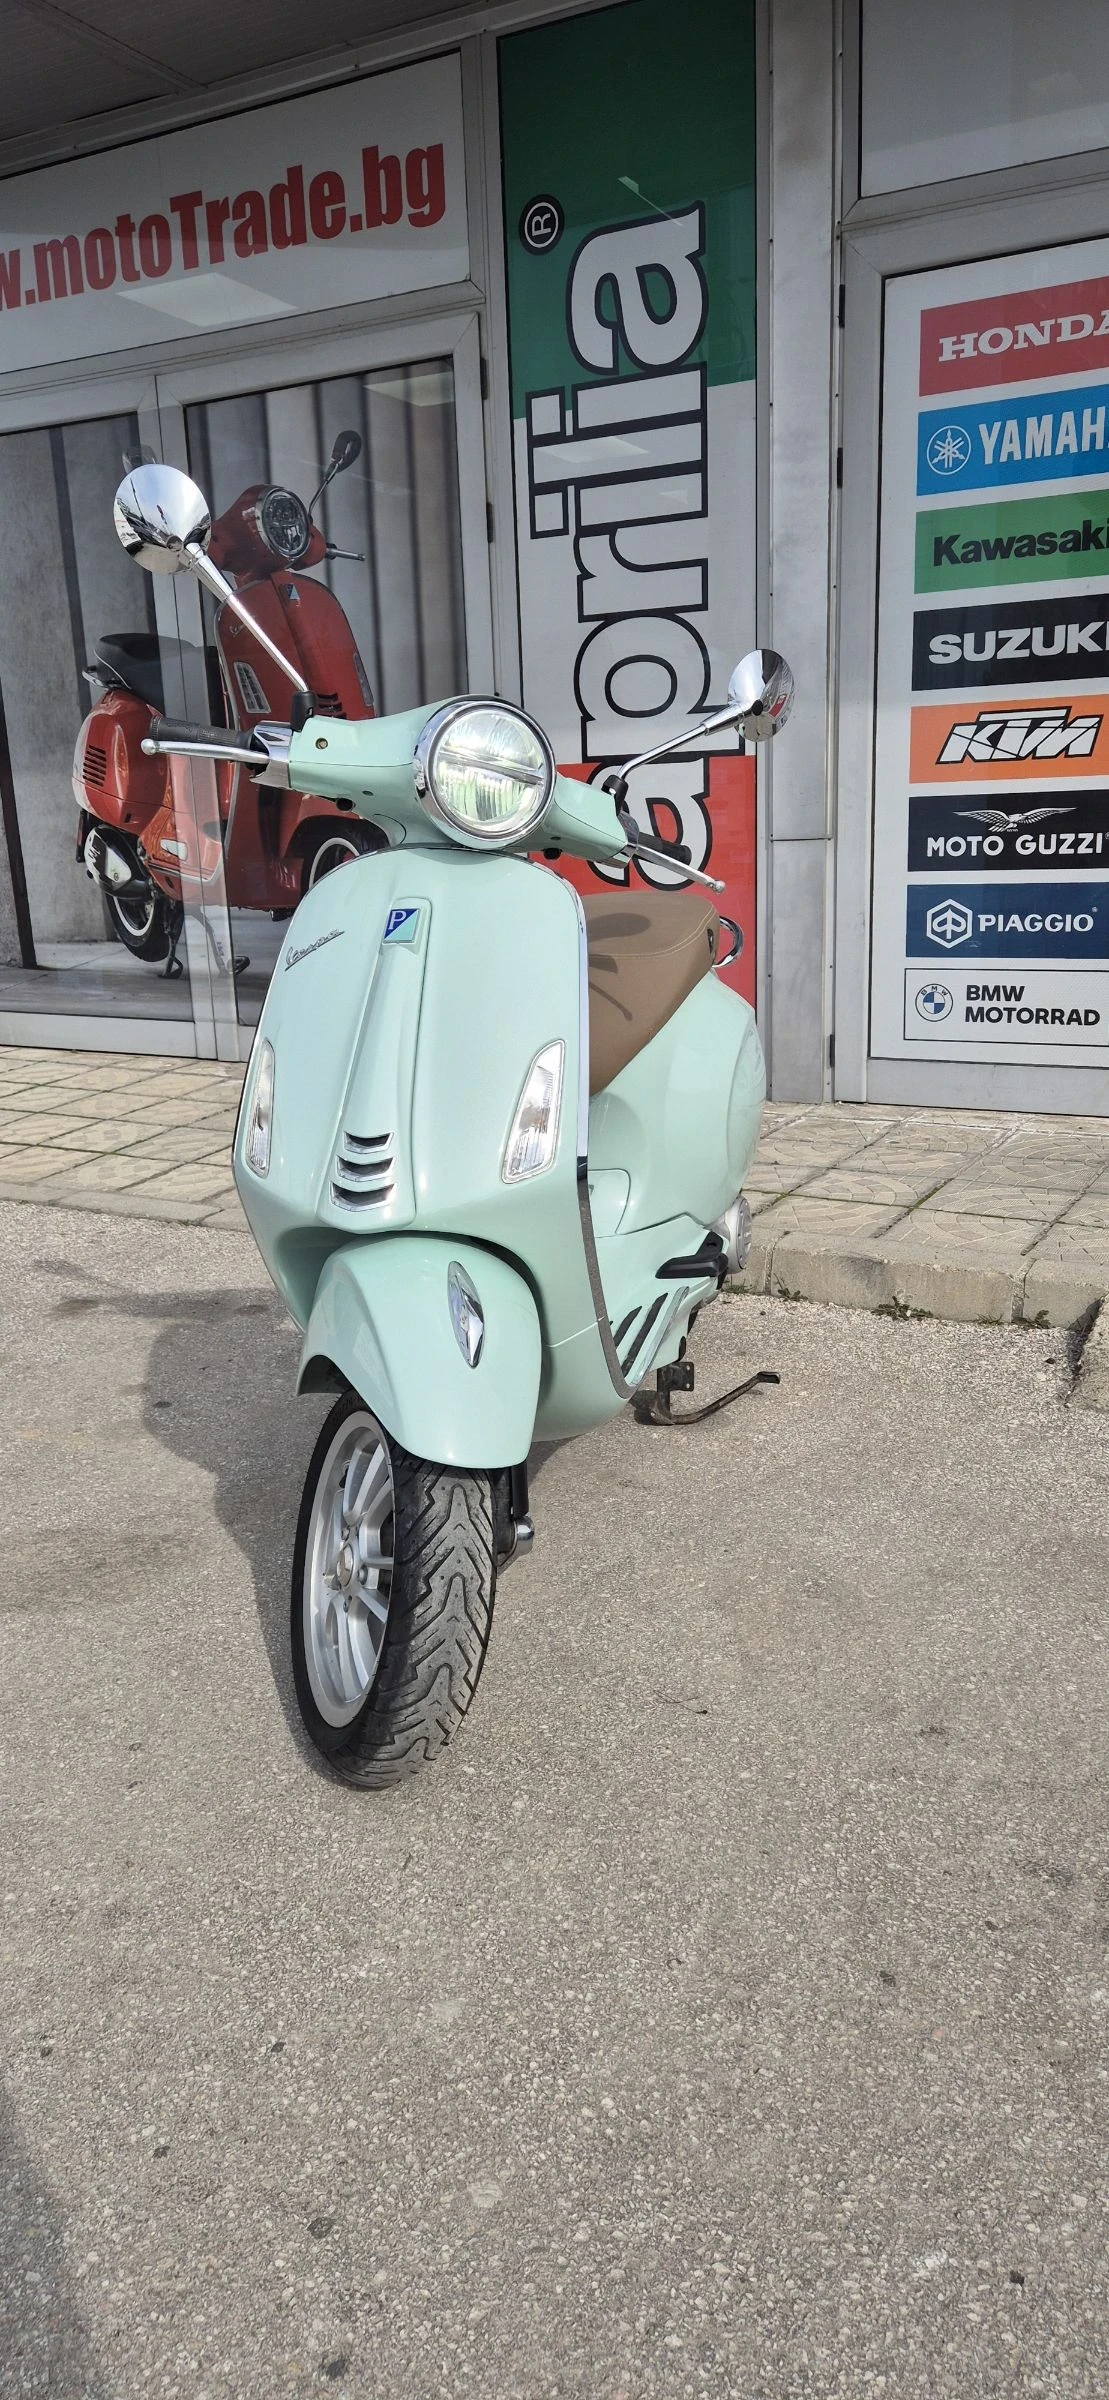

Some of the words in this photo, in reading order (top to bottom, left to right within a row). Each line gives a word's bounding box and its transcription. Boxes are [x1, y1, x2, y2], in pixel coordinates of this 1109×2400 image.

[978, 406, 1109, 465] YAMAH
[527, 201, 745, 892] aprilia
[935, 706, 1104, 765] KTM
[926, 836, 1004, 857] MOTO
[1015, 833, 1103, 855] GUZZI
[978, 913, 1094, 933] PIAGGIO
[966, 984, 1025, 1002] BMW
[964, 1006, 1101, 1026] MOTORRAD
